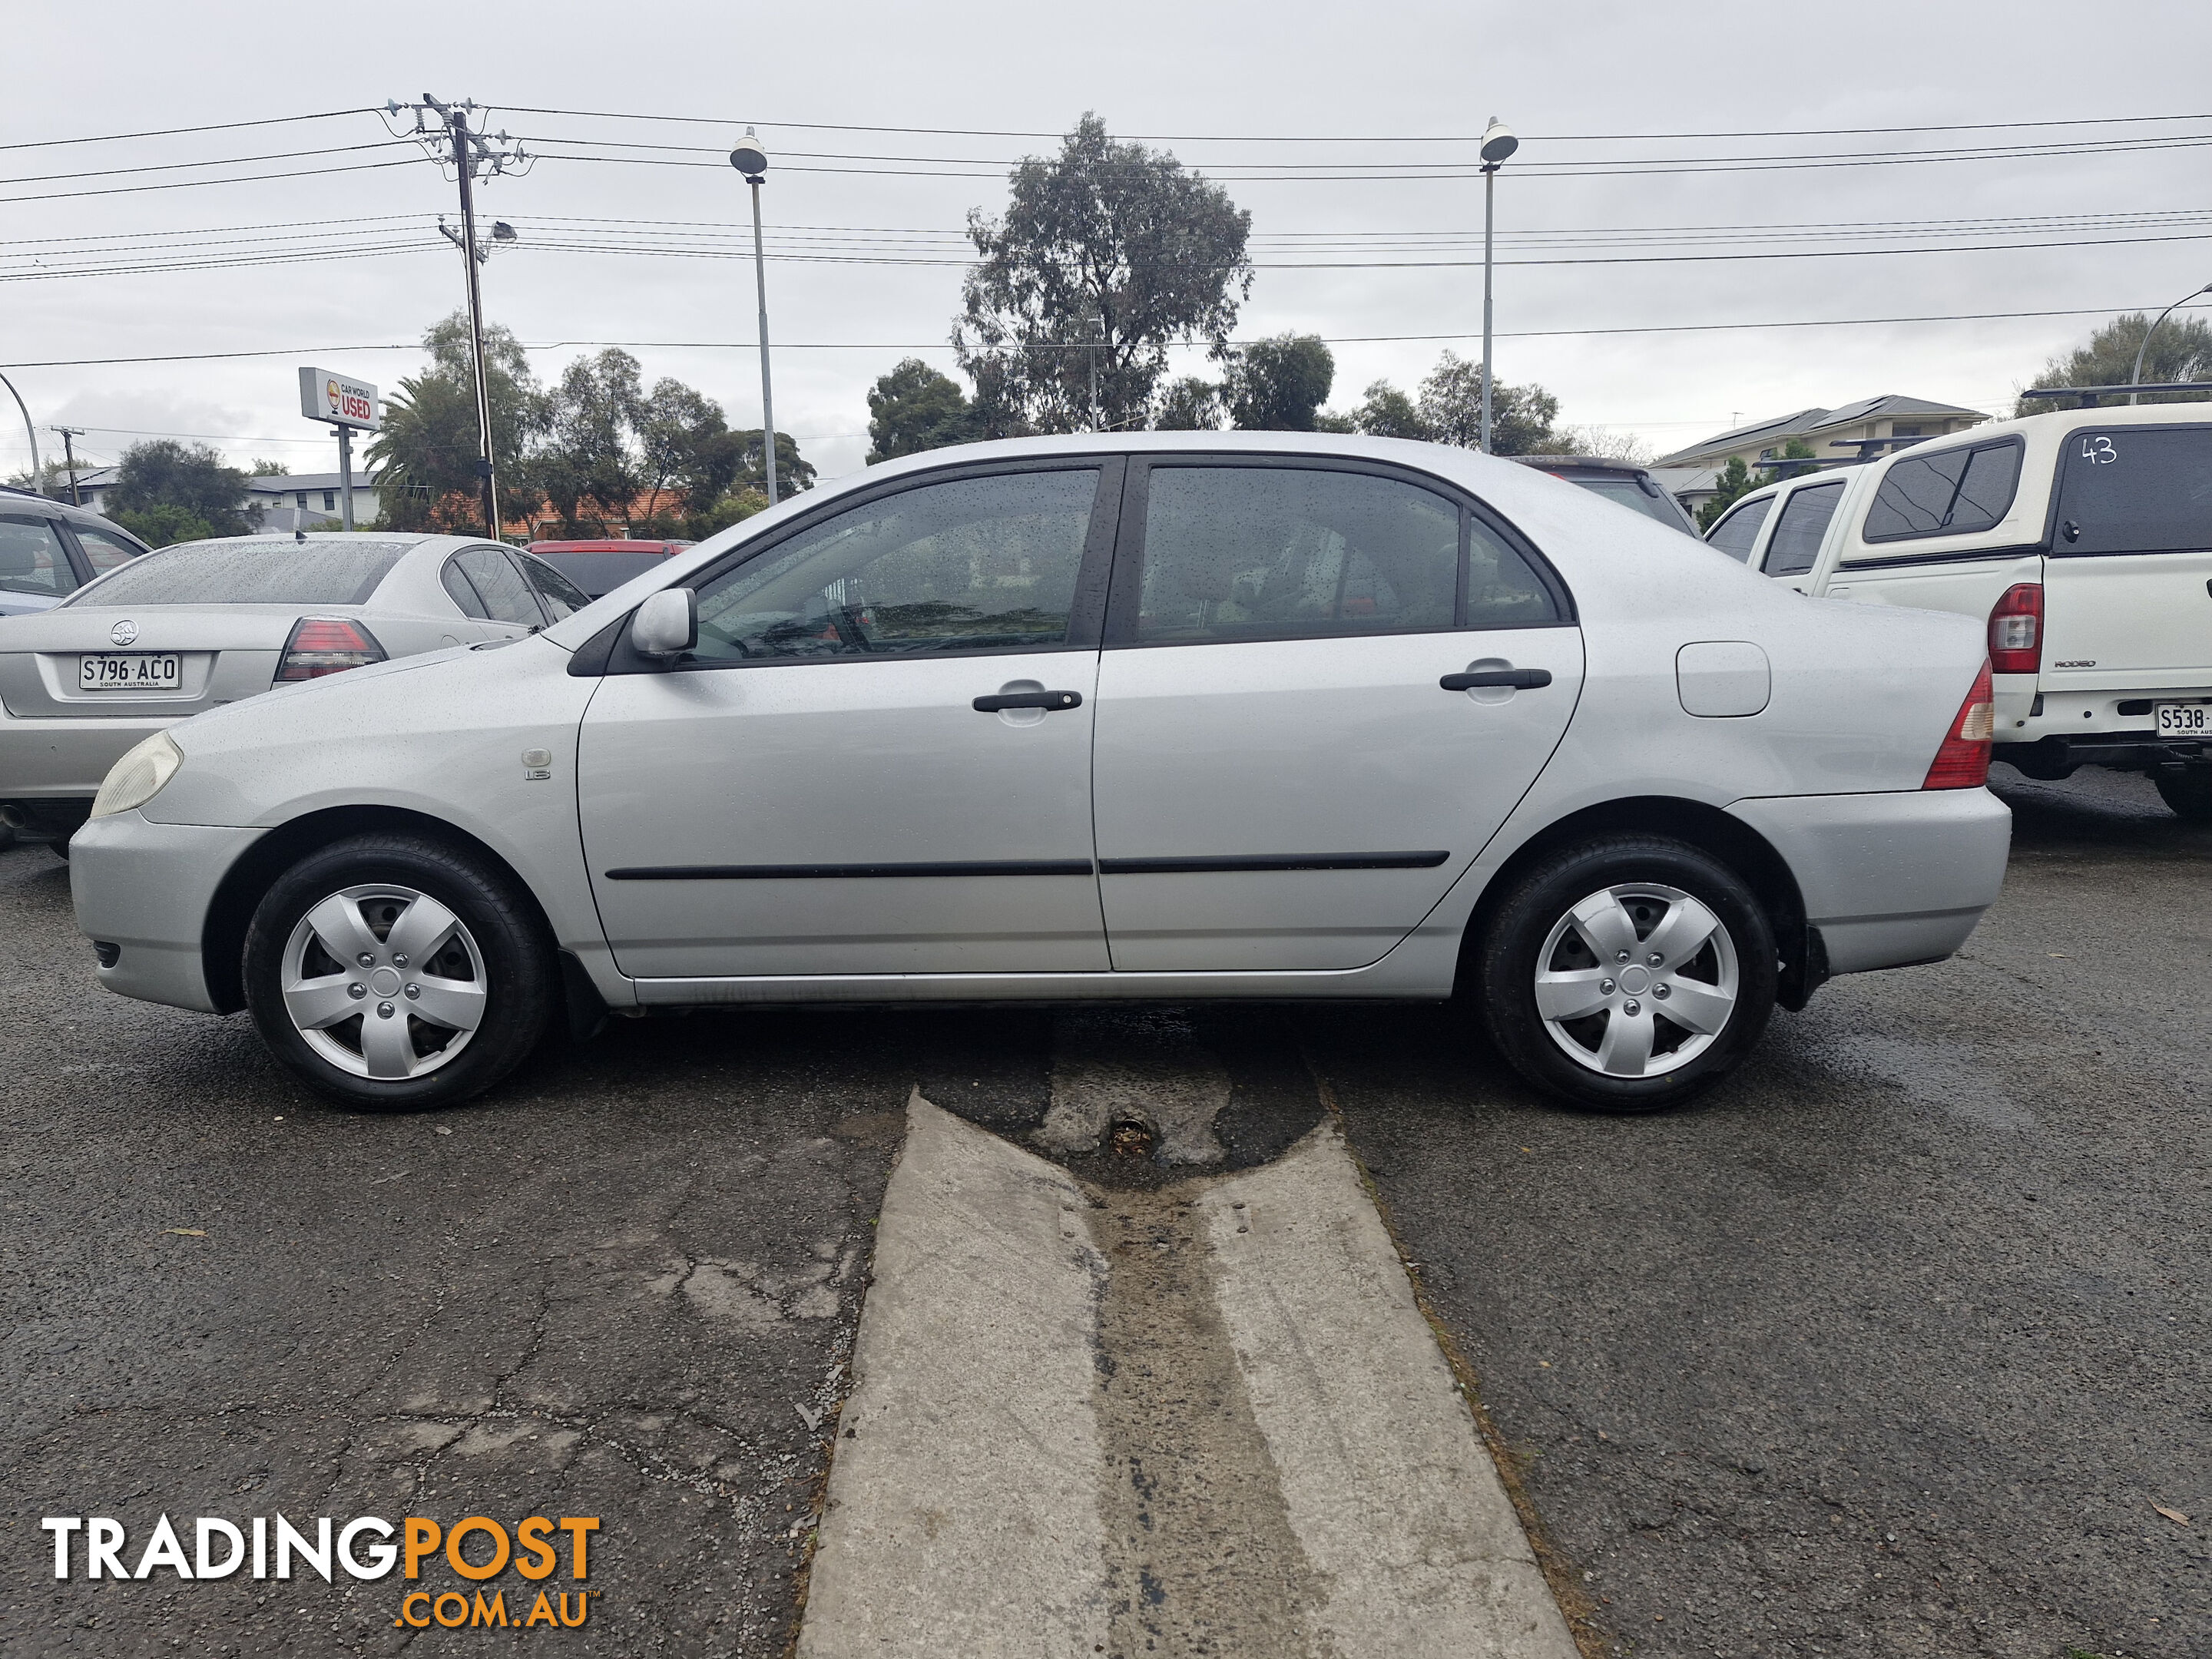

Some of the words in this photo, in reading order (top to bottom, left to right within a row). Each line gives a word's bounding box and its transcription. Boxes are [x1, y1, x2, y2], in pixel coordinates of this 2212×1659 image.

[341, 384, 352, 394] CAR
[353, 387, 369, 399] WORLD
[342, 395, 370, 419] USED
[2082, 436, 2118, 465] 43
